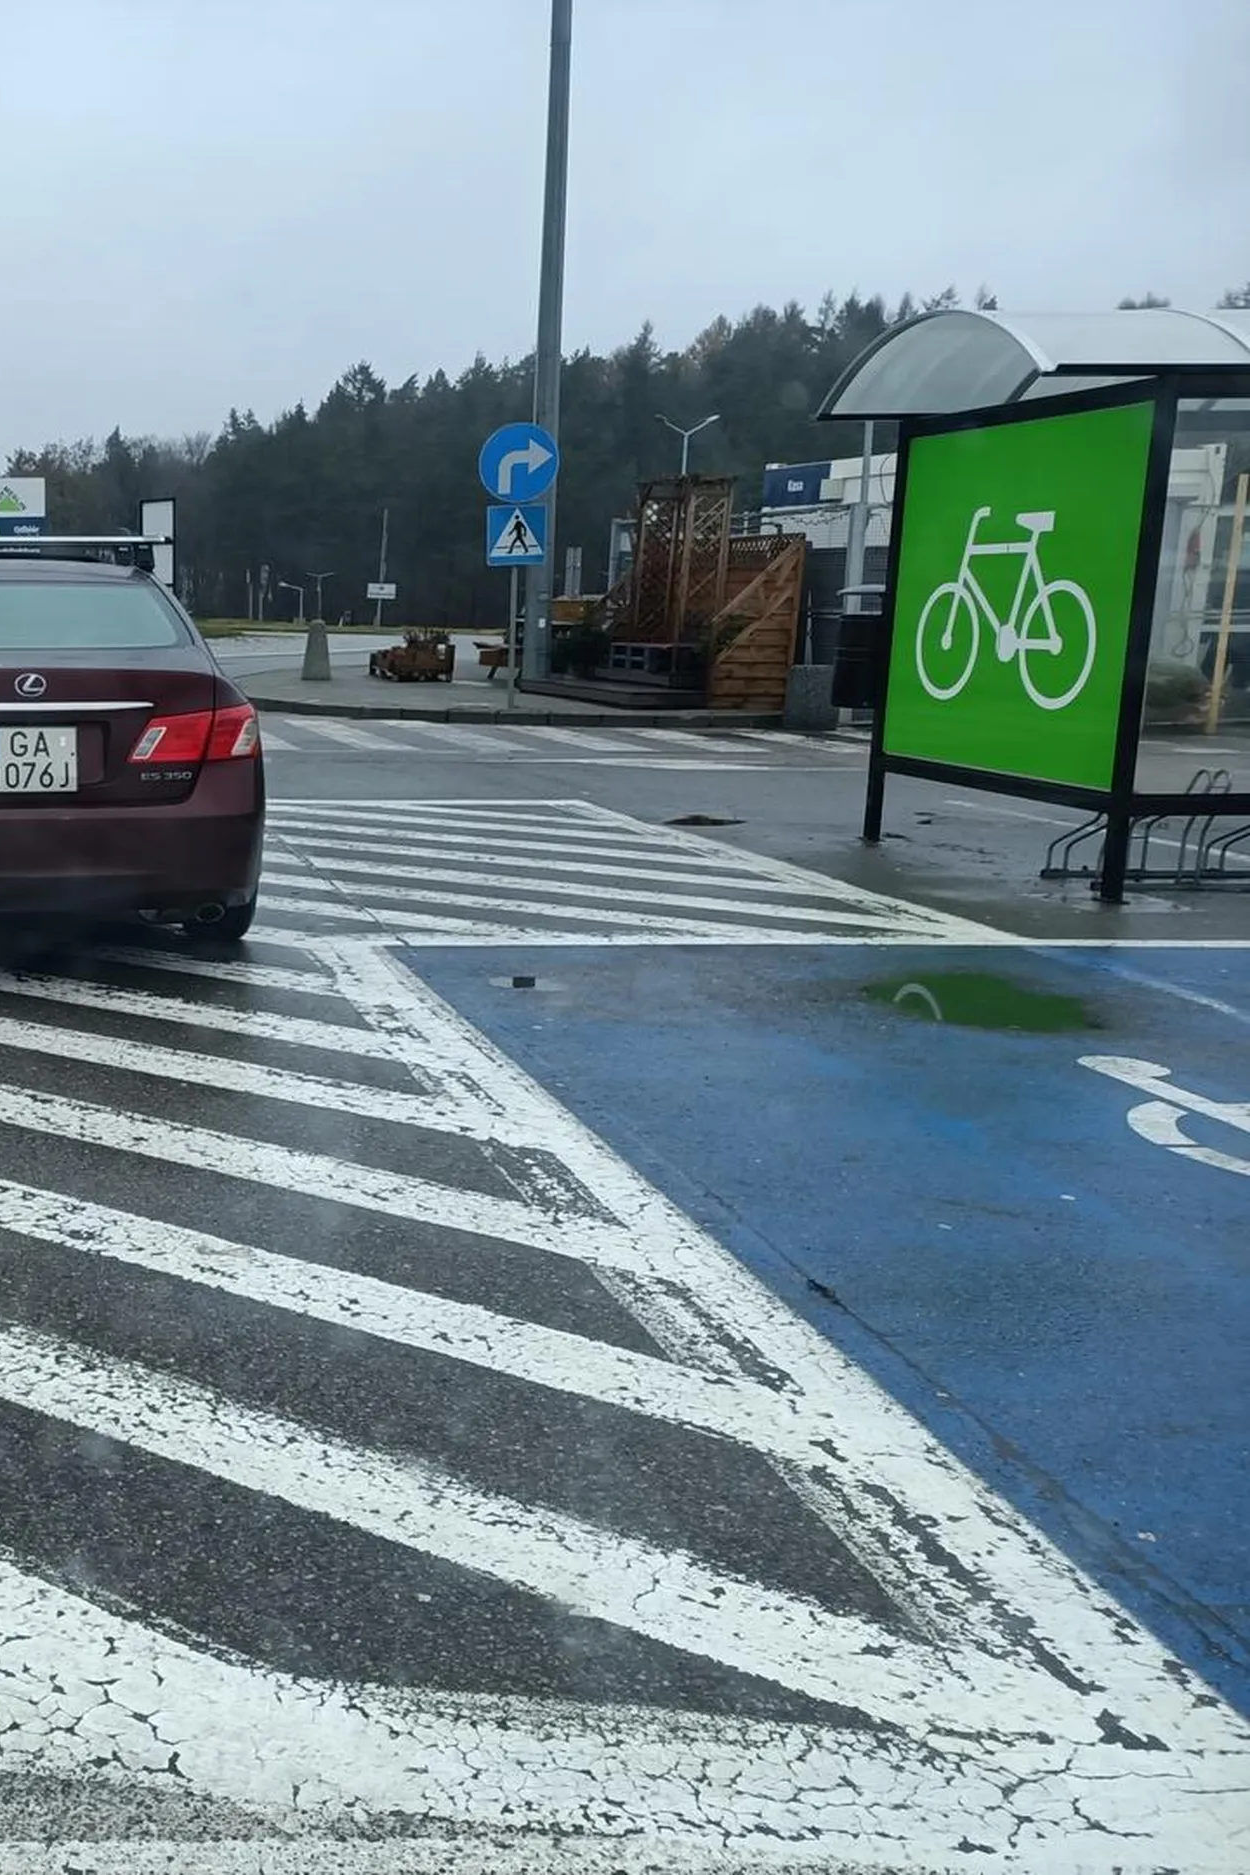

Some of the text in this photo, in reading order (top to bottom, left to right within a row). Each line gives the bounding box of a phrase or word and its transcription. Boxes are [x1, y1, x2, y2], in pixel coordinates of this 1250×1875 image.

[11, 731, 50, 757] GA
[141, 770, 193, 781] ES 350
